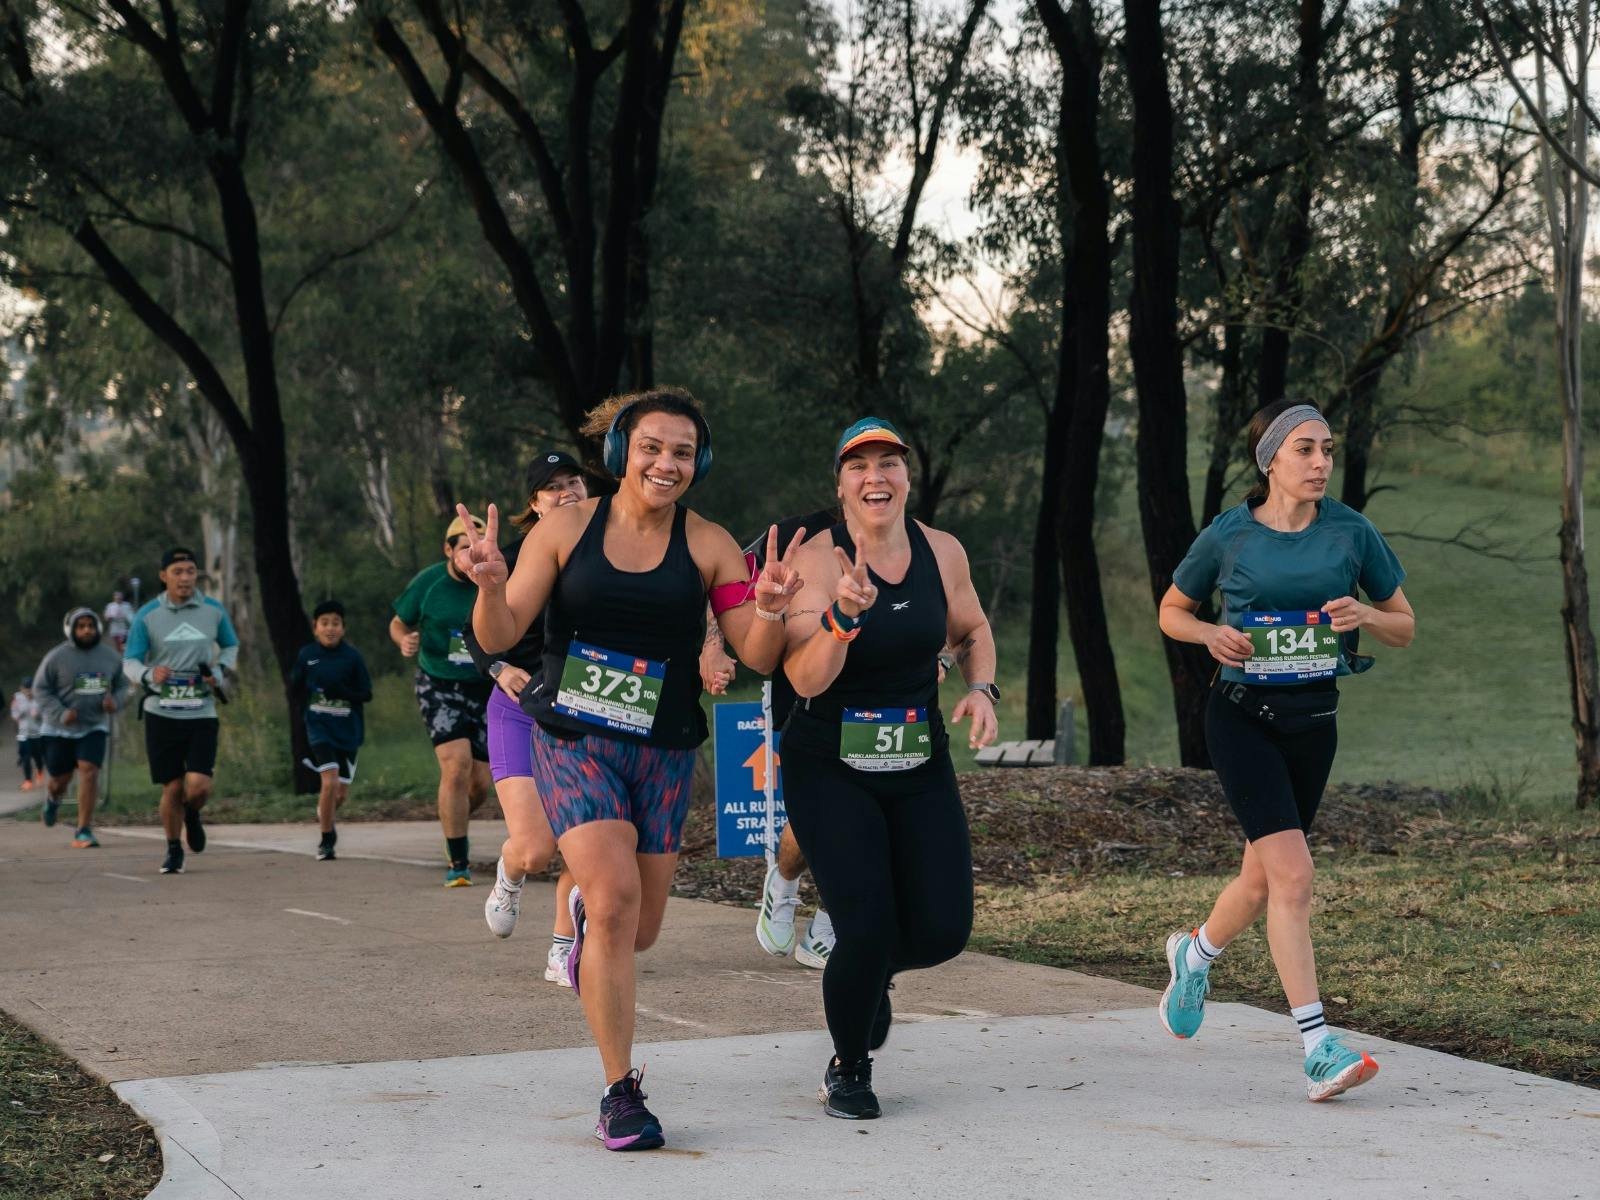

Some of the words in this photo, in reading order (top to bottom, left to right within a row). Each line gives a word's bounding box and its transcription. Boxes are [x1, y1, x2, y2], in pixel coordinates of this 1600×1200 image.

[1266, 628, 1317, 654] 134
[1323, 637, 1336, 645] 10k
[580, 665, 642, 703] 373
[169, 686, 195, 698] 374
[643, 689, 657, 701] 10k
[566, 687, 598, 702] PARKLANDS
[599, 696, 624, 708] RUNNING
[625, 703, 647, 714] FESTIVAL
[567, 708, 578, 716] 373
[607, 720, 619, 728] BAG
[620, 723, 636, 732] DROP
[636, 726, 647, 735] TAG
[874, 726, 904, 752] 51
[918, 734, 930, 743] 10k
[724, 802, 747, 814] ALL
[736, 816, 788, 829] STRAGH
